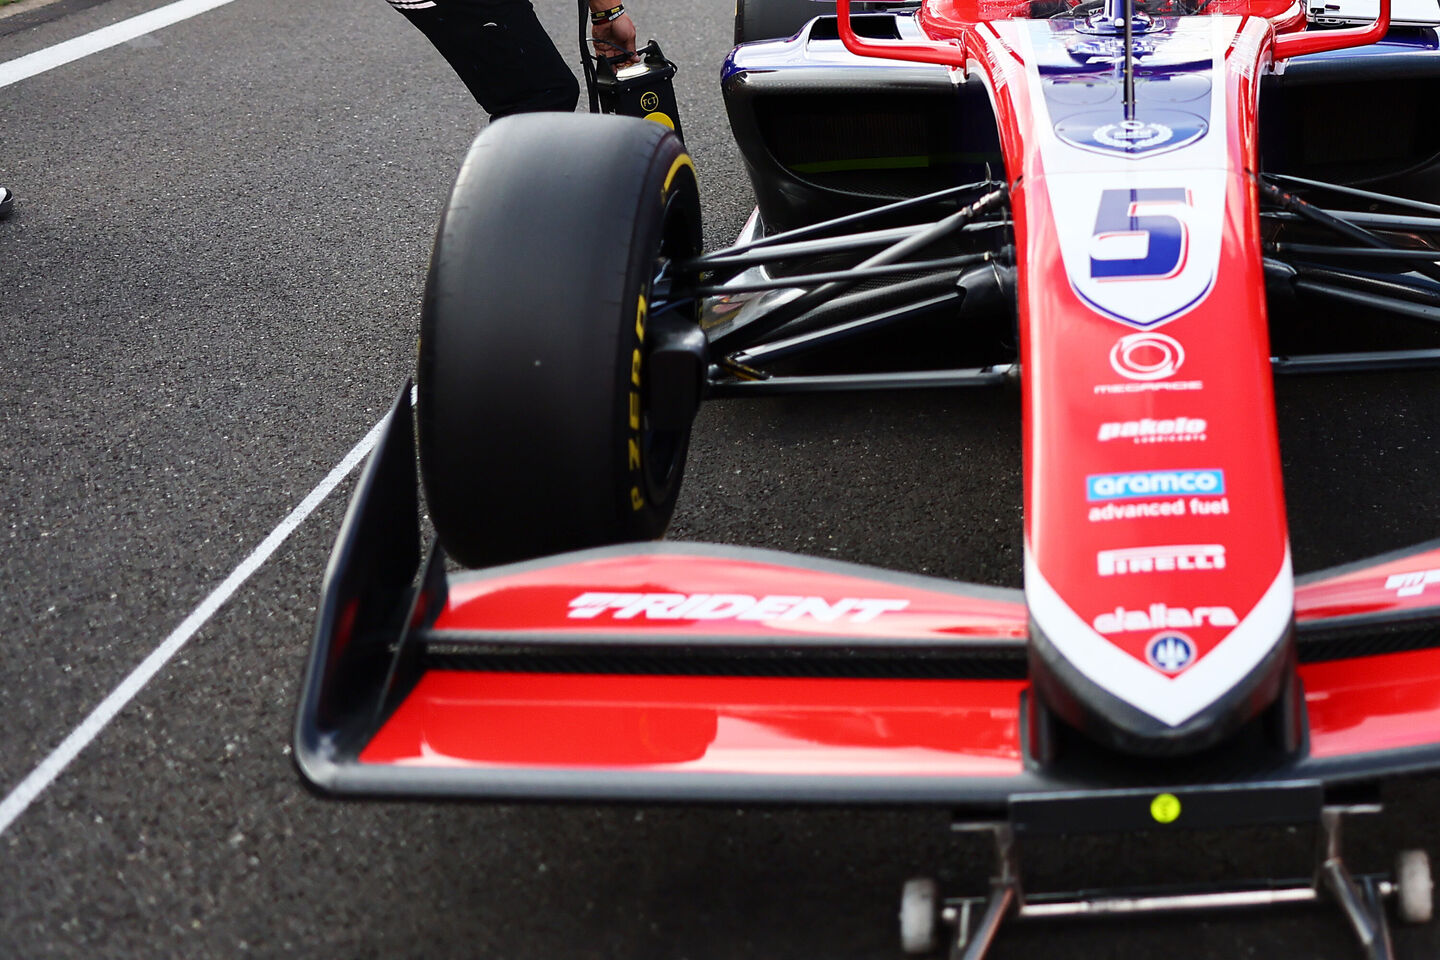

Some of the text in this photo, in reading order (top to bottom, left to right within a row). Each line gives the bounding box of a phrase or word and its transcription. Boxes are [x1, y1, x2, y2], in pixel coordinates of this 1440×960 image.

[1089, 186, 1194, 283] 5
[1093, 471, 1218, 497] aramco
[1088, 497, 1229, 522] advanced fuel
[1097, 544, 1226, 576] PIRELLI
[567, 591, 911, 623] TRIDENT
[1093, 602, 1240, 634] dallara
